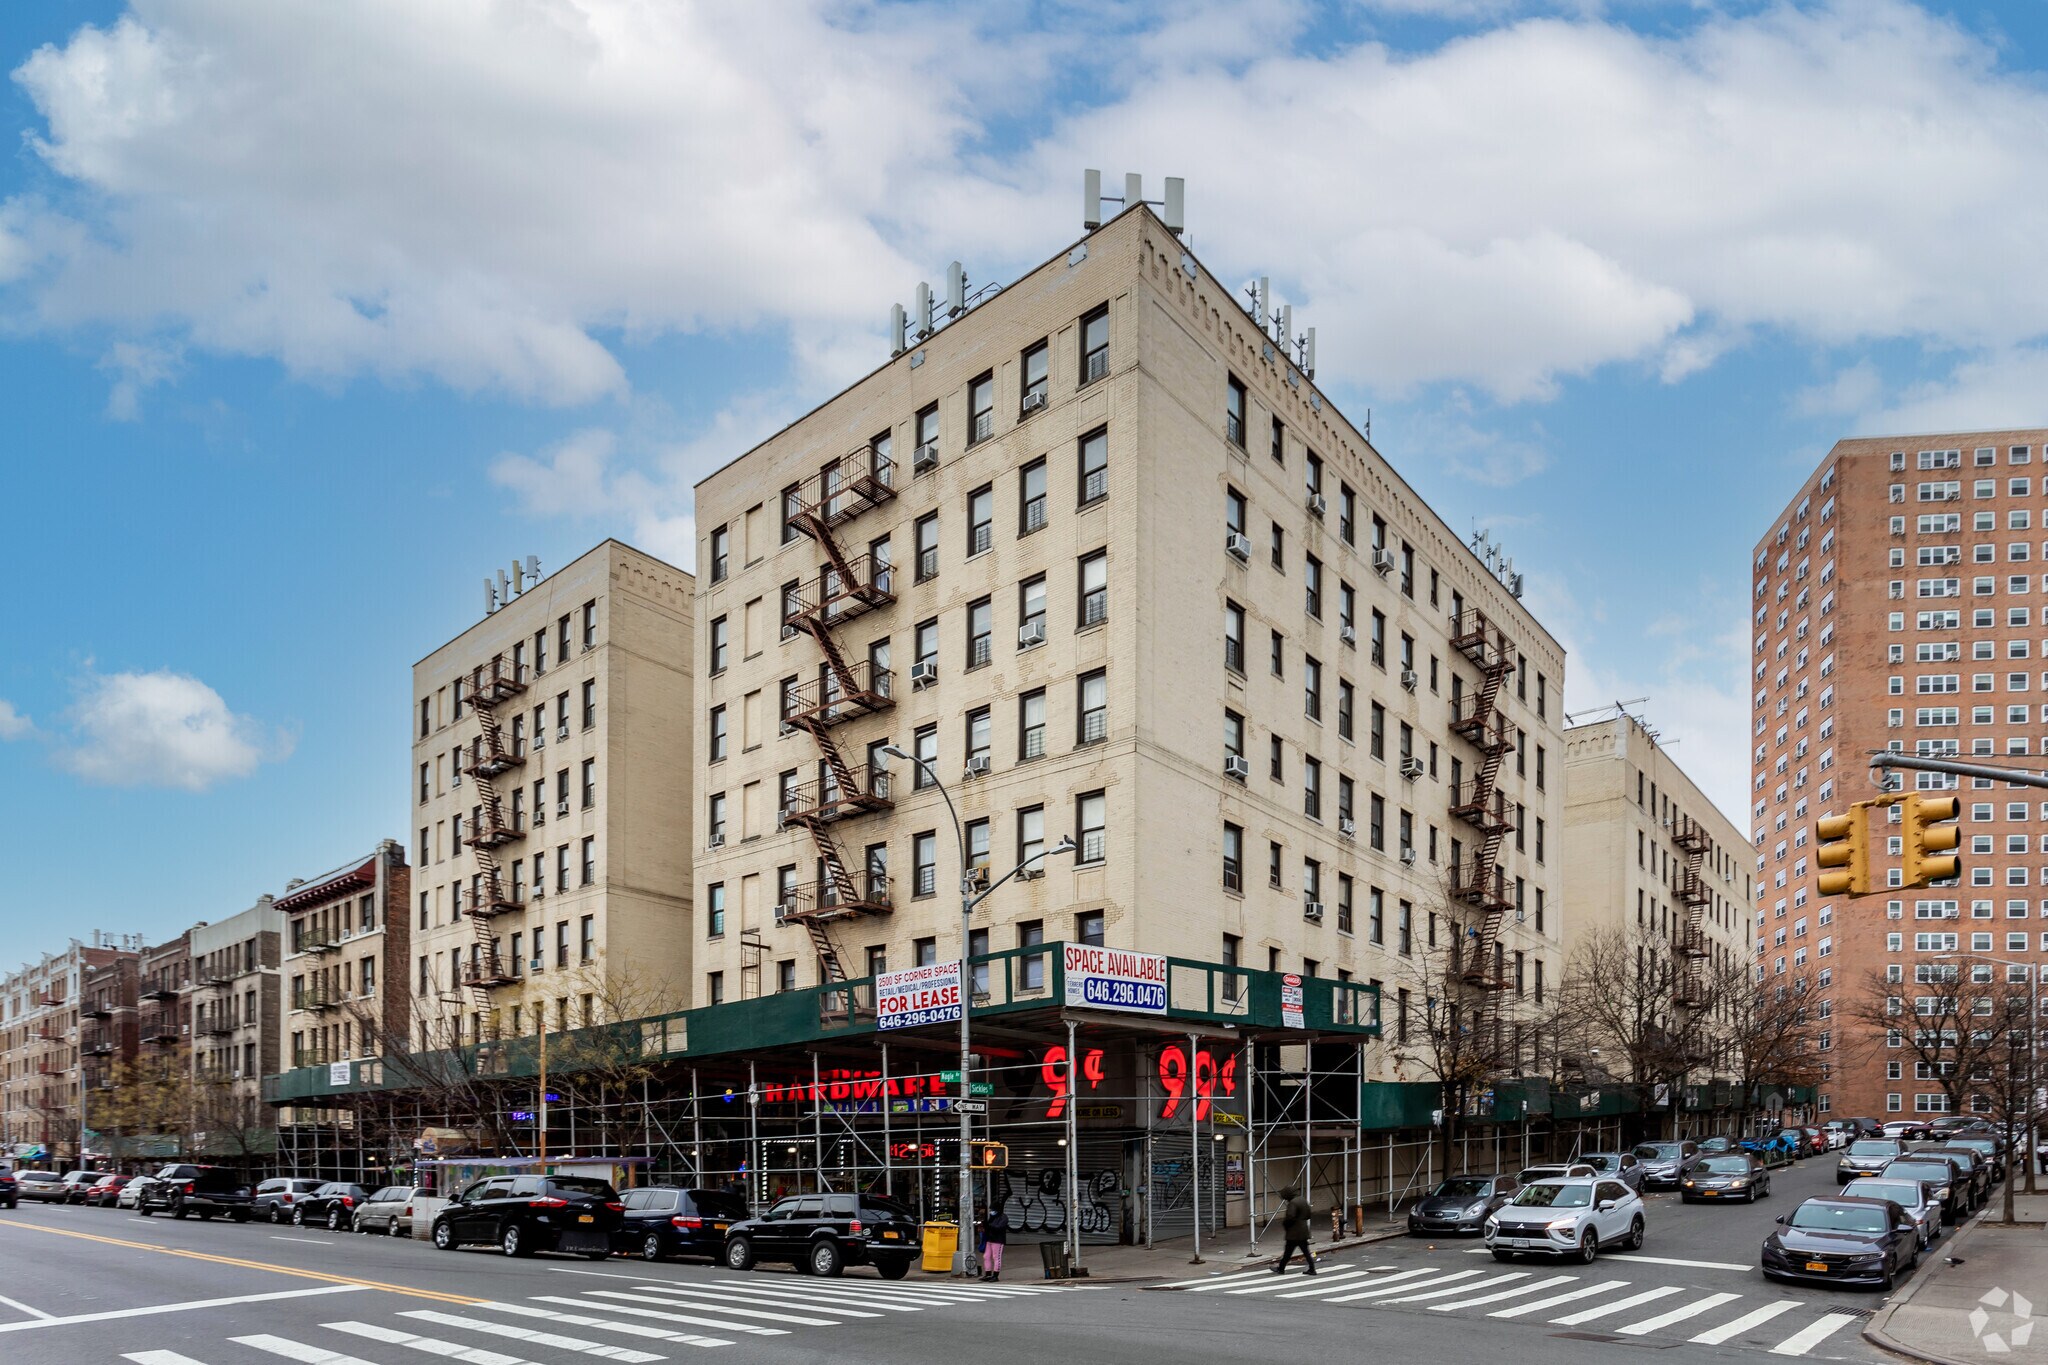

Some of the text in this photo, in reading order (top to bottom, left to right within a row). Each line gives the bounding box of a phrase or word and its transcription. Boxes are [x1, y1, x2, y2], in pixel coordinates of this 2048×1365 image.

[1066, 947, 1166, 982] SPACE AVAILABLE
[878, 976, 893, 987] 2500
[895, 974, 902, 985] SF
[904, 968, 933, 982] CORNER
[880, 986, 959, 1014] FOR LEASE
[1087, 979, 1164, 1007] 646.296.0476
[879, 1006, 960, 1029] 646-296-0476
[941, 1072, 954, 1082] Nagle
[971, 1084, 988, 1093] Sickles
[765, 1075, 947, 1103] HARDWARE
[1102, 1107, 1118, 1116] LESS
